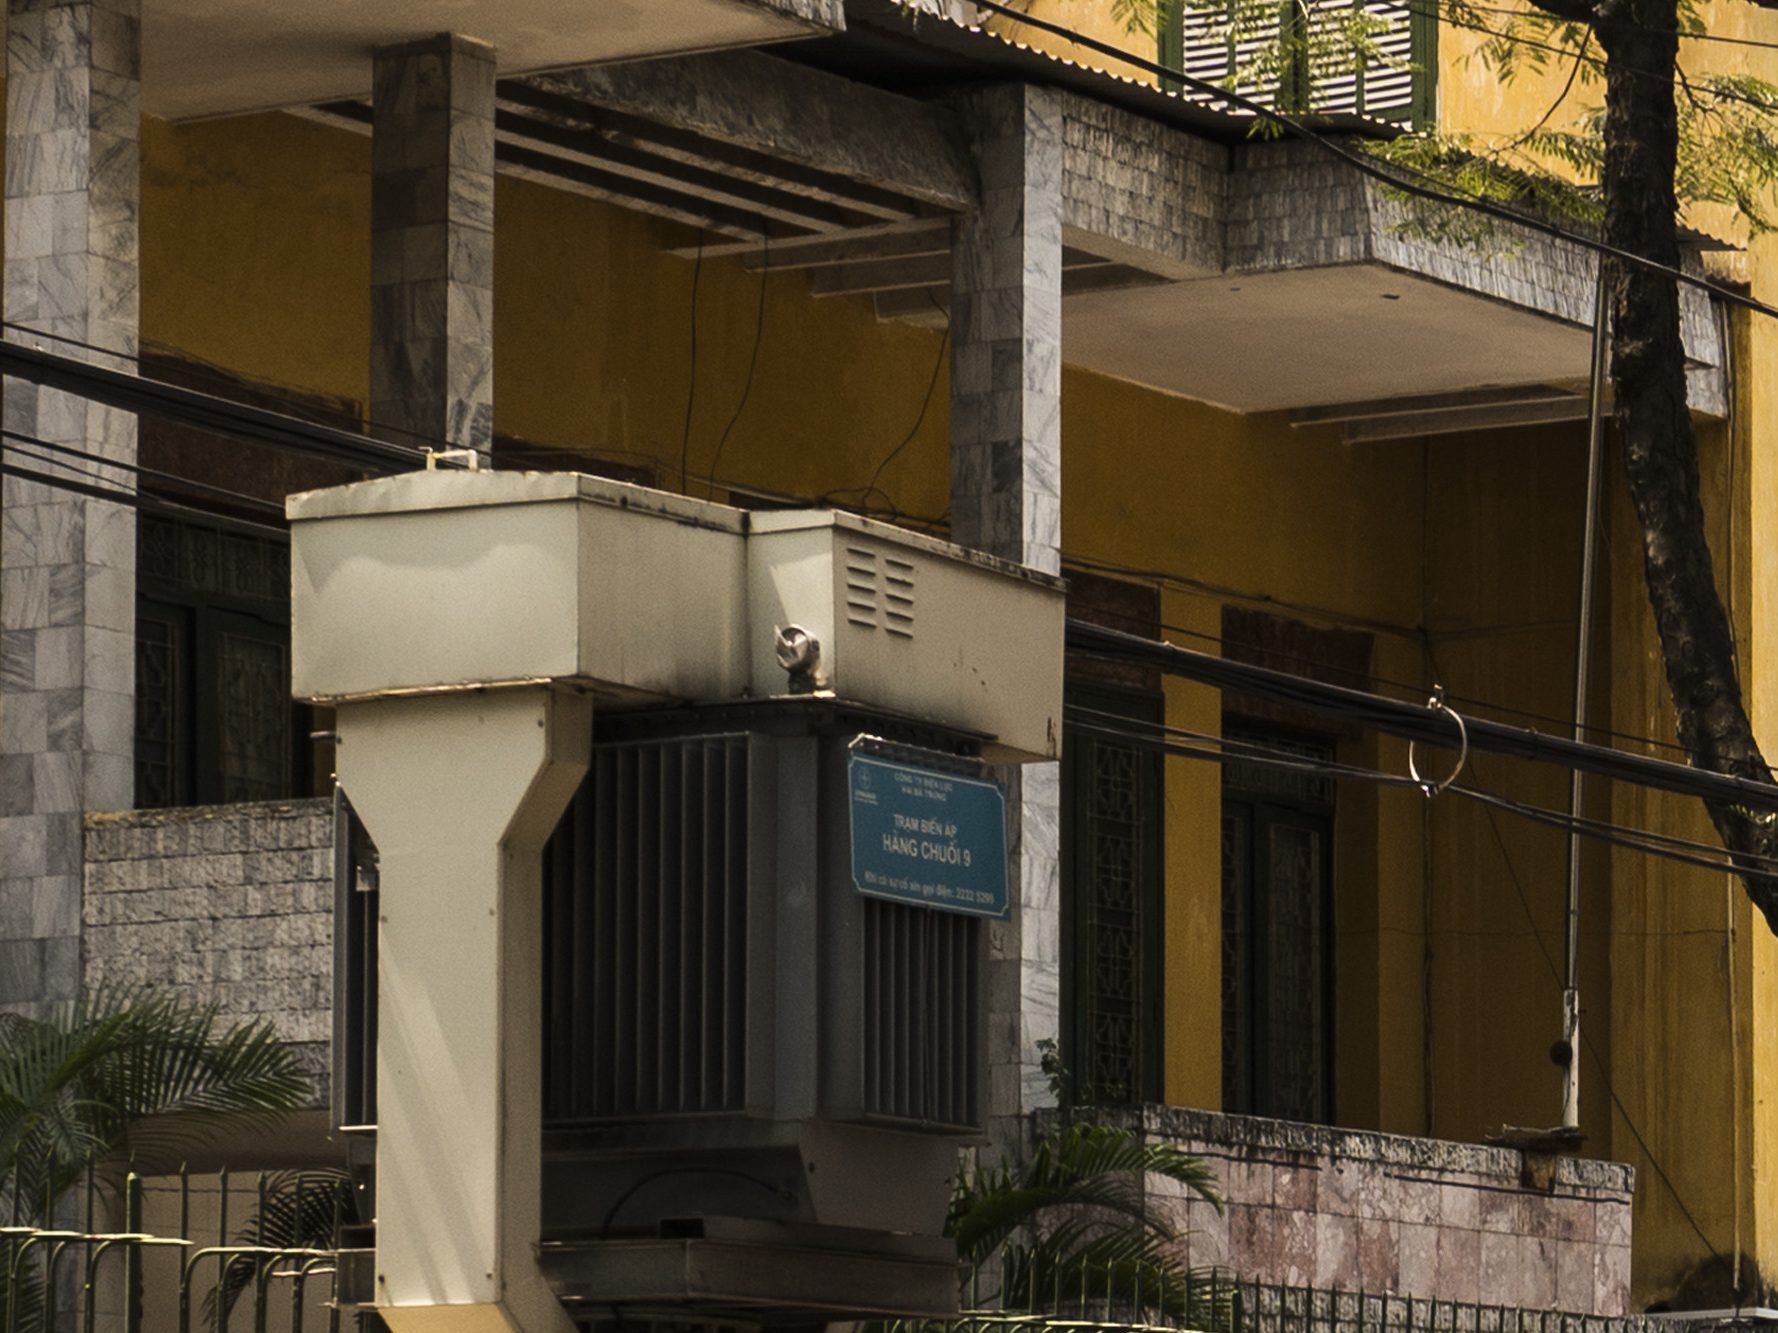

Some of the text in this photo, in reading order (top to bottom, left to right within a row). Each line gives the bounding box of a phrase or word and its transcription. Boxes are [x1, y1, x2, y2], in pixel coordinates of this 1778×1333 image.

[882, 829, 972, 867] HÀNG CHUỐI 9
